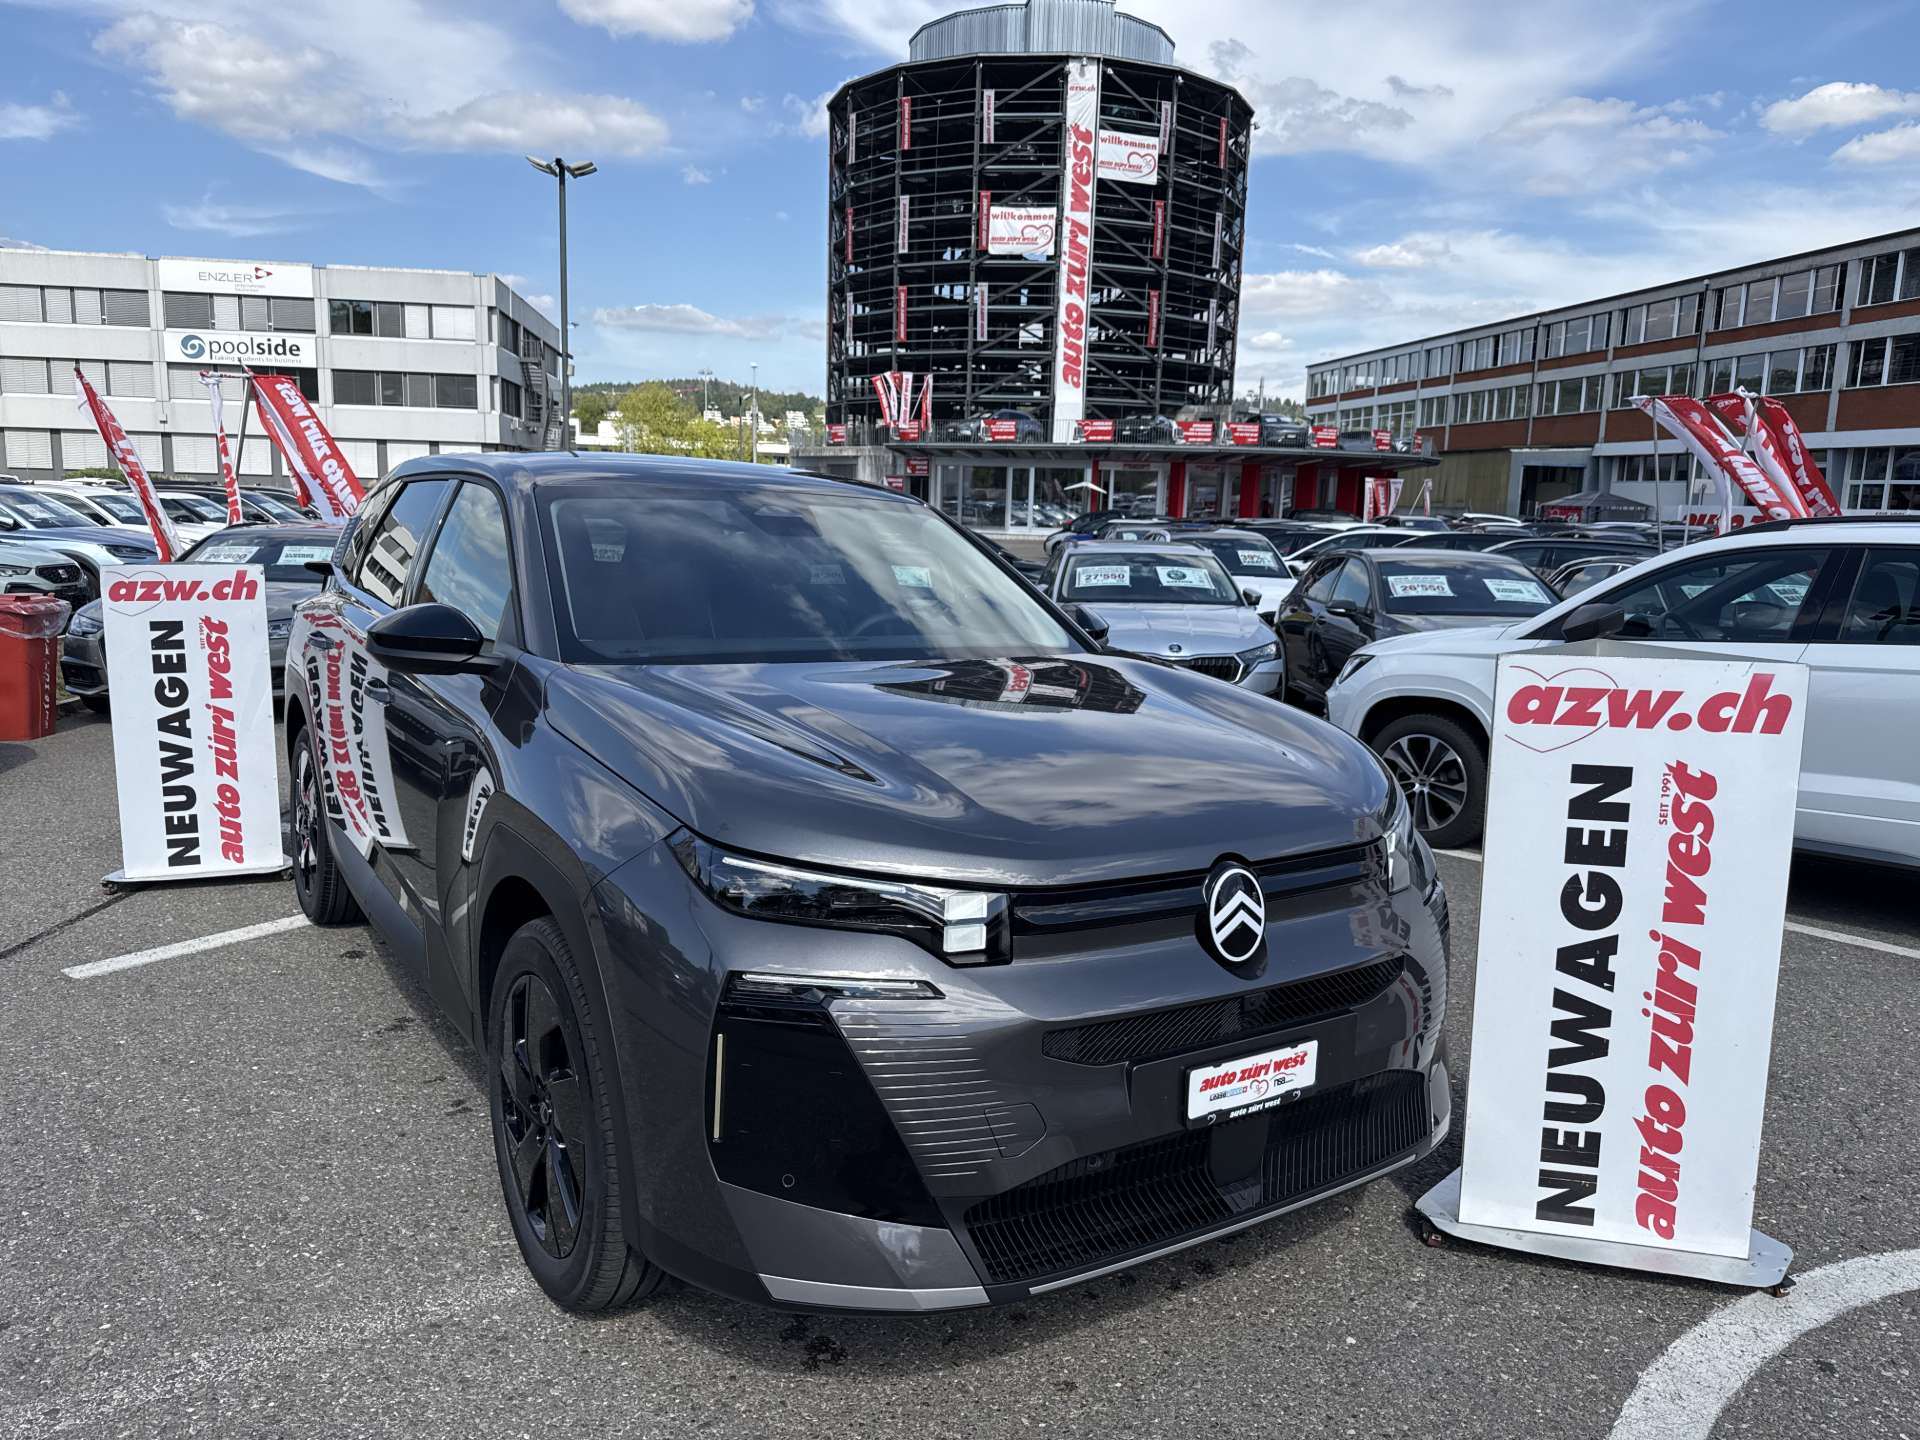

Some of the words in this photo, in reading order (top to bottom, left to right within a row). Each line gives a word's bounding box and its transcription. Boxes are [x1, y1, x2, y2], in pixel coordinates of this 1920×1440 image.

[1070, 122, 1094, 213] west
[1099, 136, 1157, 151] willkommen
[991, 211, 1054, 221] willkommen
[198, 271, 253, 283] ENZLER
[1063, 216, 1090, 300] züri
[208, 336, 301, 360] poolside
[274, 357, 302, 365] business
[1060, 303, 1085, 389] auto
[108, 570, 258, 602] azw.ch
[201, 615, 232, 699] west
[1506, 673, 1793, 735] azw.ch
[149, 620, 201, 867] NEUWAGEN
[205, 703, 239, 782] züri
[1658, 802, 1669, 826] SEIT
[1660, 772, 1671, 799] 1991
[212, 783, 244, 864] auto
[1662, 760, 1718, 926] west
[1536, 763, 1634, 1226] NEUWAGEN
[1642, 930, 1702, 1086] züri
[1199, 1070, 1237, 1092] auto
[1238, 1058, 1273, 1082] züri
[1273, 1050, 1308, 1072] west
[1229, 1108, 1247, 1118] auto
[1264, 1097, 1281, 1108] west
[1635, 1084, 1687, 1240] auto
